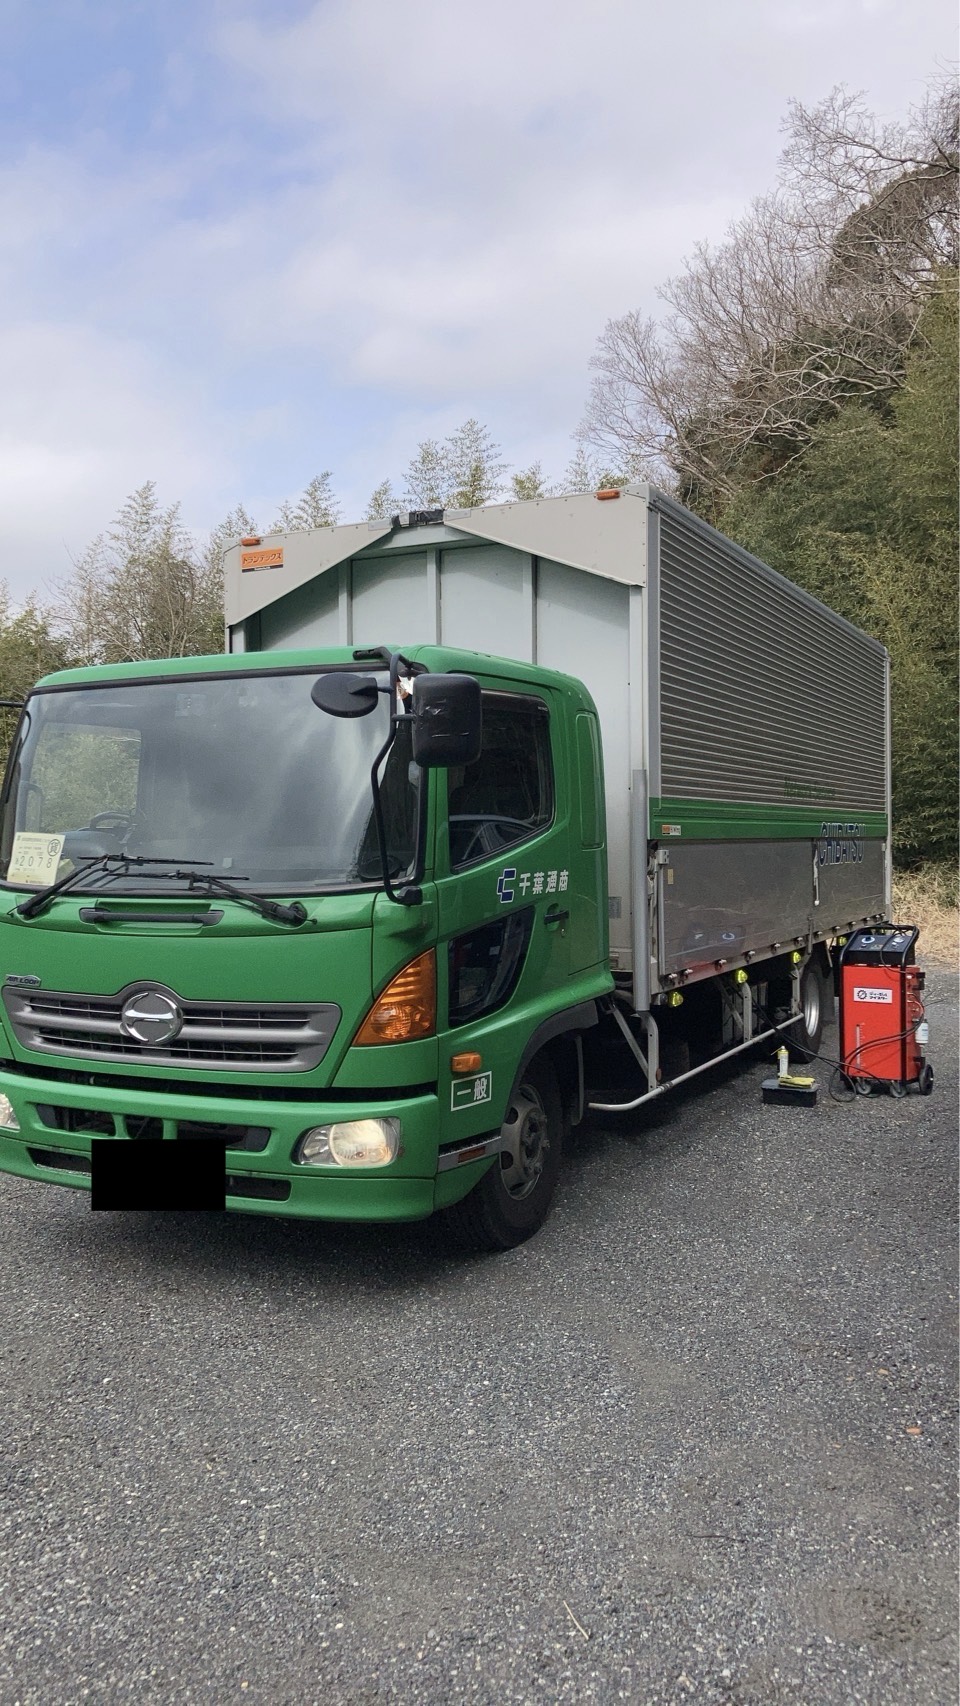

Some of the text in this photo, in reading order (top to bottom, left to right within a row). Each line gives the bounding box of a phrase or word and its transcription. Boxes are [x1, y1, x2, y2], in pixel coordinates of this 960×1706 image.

[243, 552, 281, 565] トランテックス
[819, 822, 866, 867] CHIBATSU
[518, 869, 569, 896] 千葉通商
[456, 1077, 488, 1101] 一般
